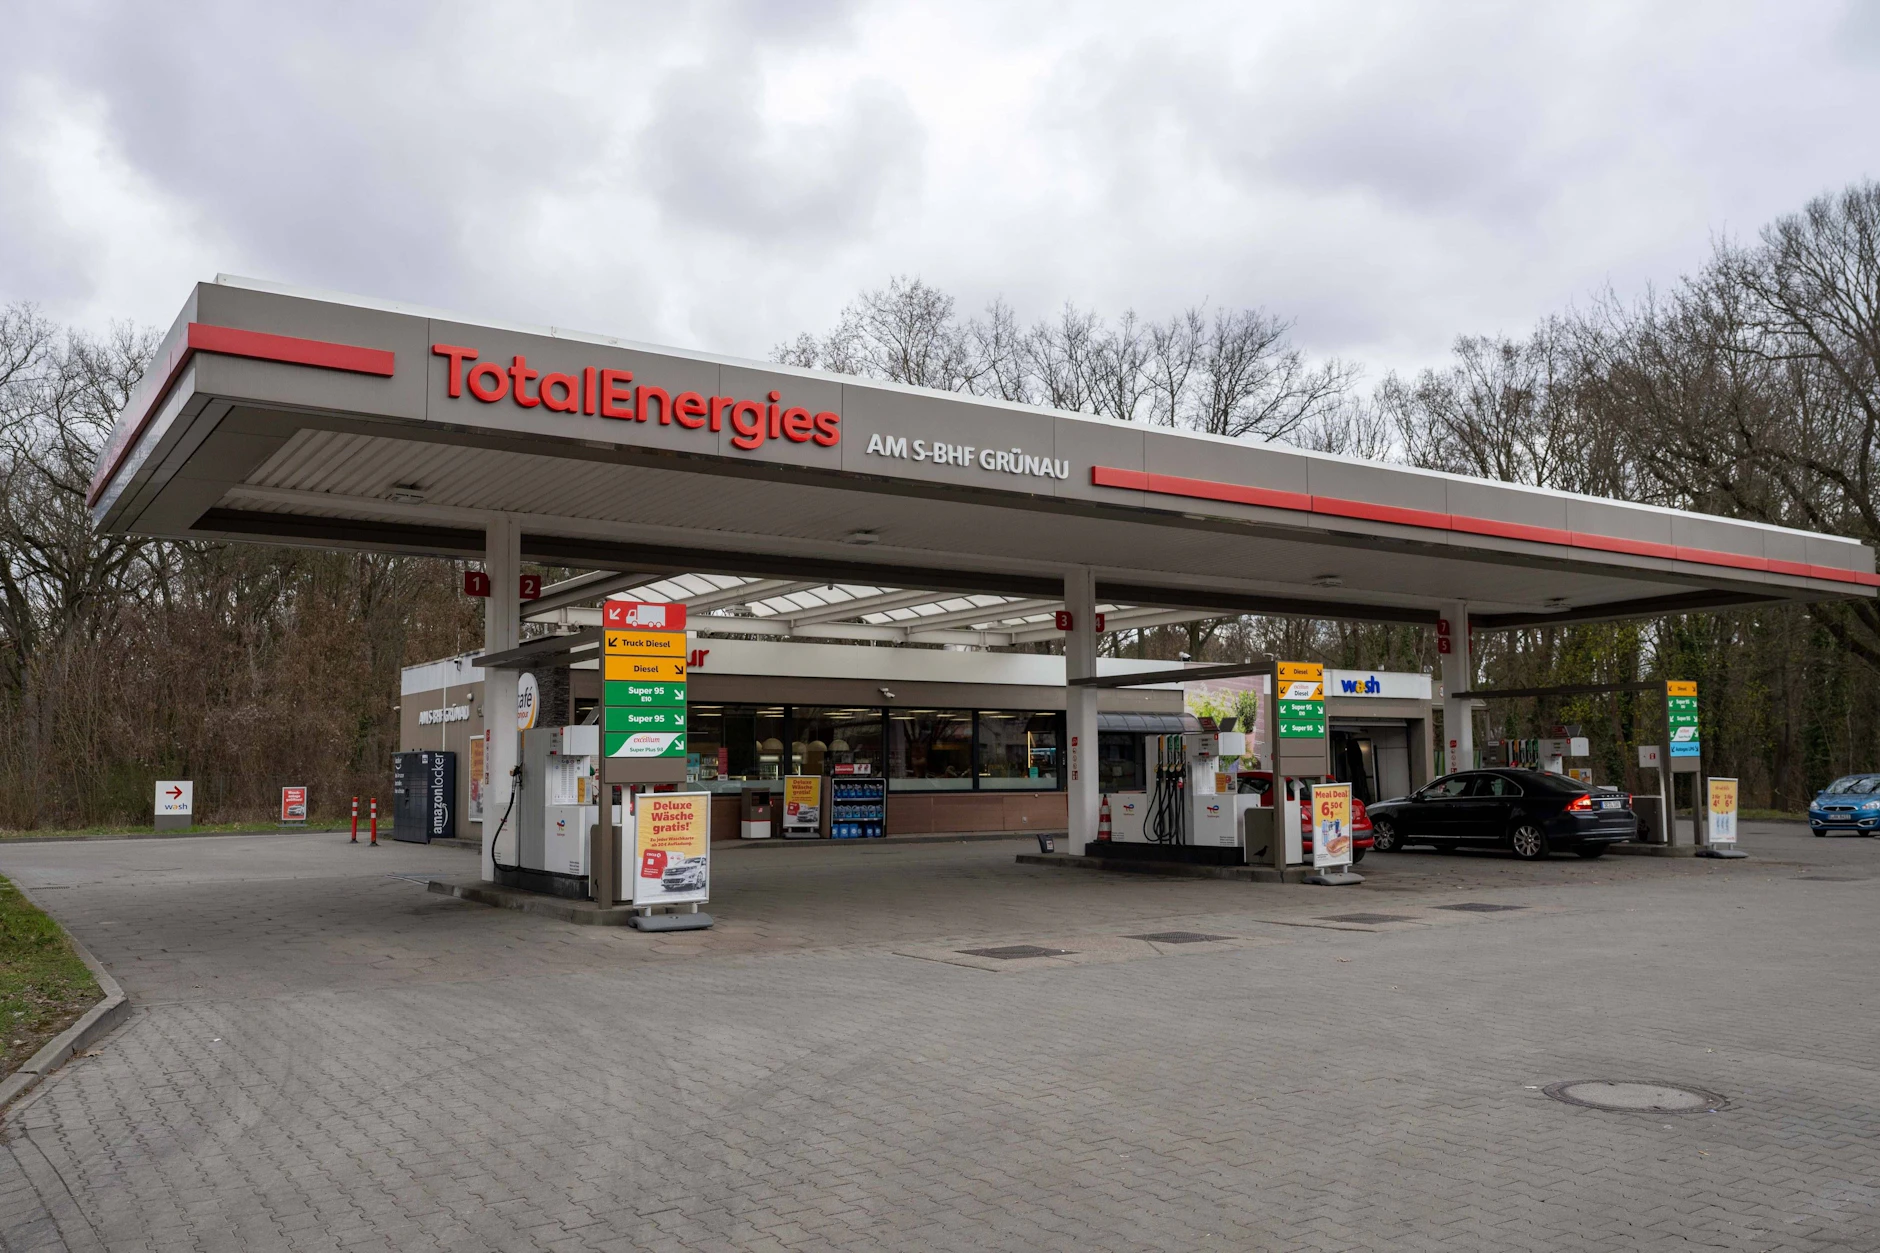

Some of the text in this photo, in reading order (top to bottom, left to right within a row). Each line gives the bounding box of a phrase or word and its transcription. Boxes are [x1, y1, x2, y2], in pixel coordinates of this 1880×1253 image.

[432, 344, 840, 450] TotalEnergies
[866, 433, 1069, 479] AM S-BHF GRÜNAU
[472, 576, 480, 591] 1
[524, 579, 534, 594] 2
[1061, 614, 1068, 627] 3
[1095, 617, 1101, 629] 4
[1441, 622, 1446, 632] 7
[622, 638, 671, 648] Truck Diesel
[1442, 641, 1447, 651] 5
[633, 665, 659, 673] Diesel
[1341, 675, 1380, 694] wash
[628, 686, 665, 696] Super 95
[628, 714, 665, 724] Super 95
[431, 752, 445, 835] amazonlocker
[1315, 789, 1348, 799] Meal Deal
[164, 802, 188, 810] wash
[653, 801, 692, 811] Deluxe
[651, 811, 694, 821] Wäsche
